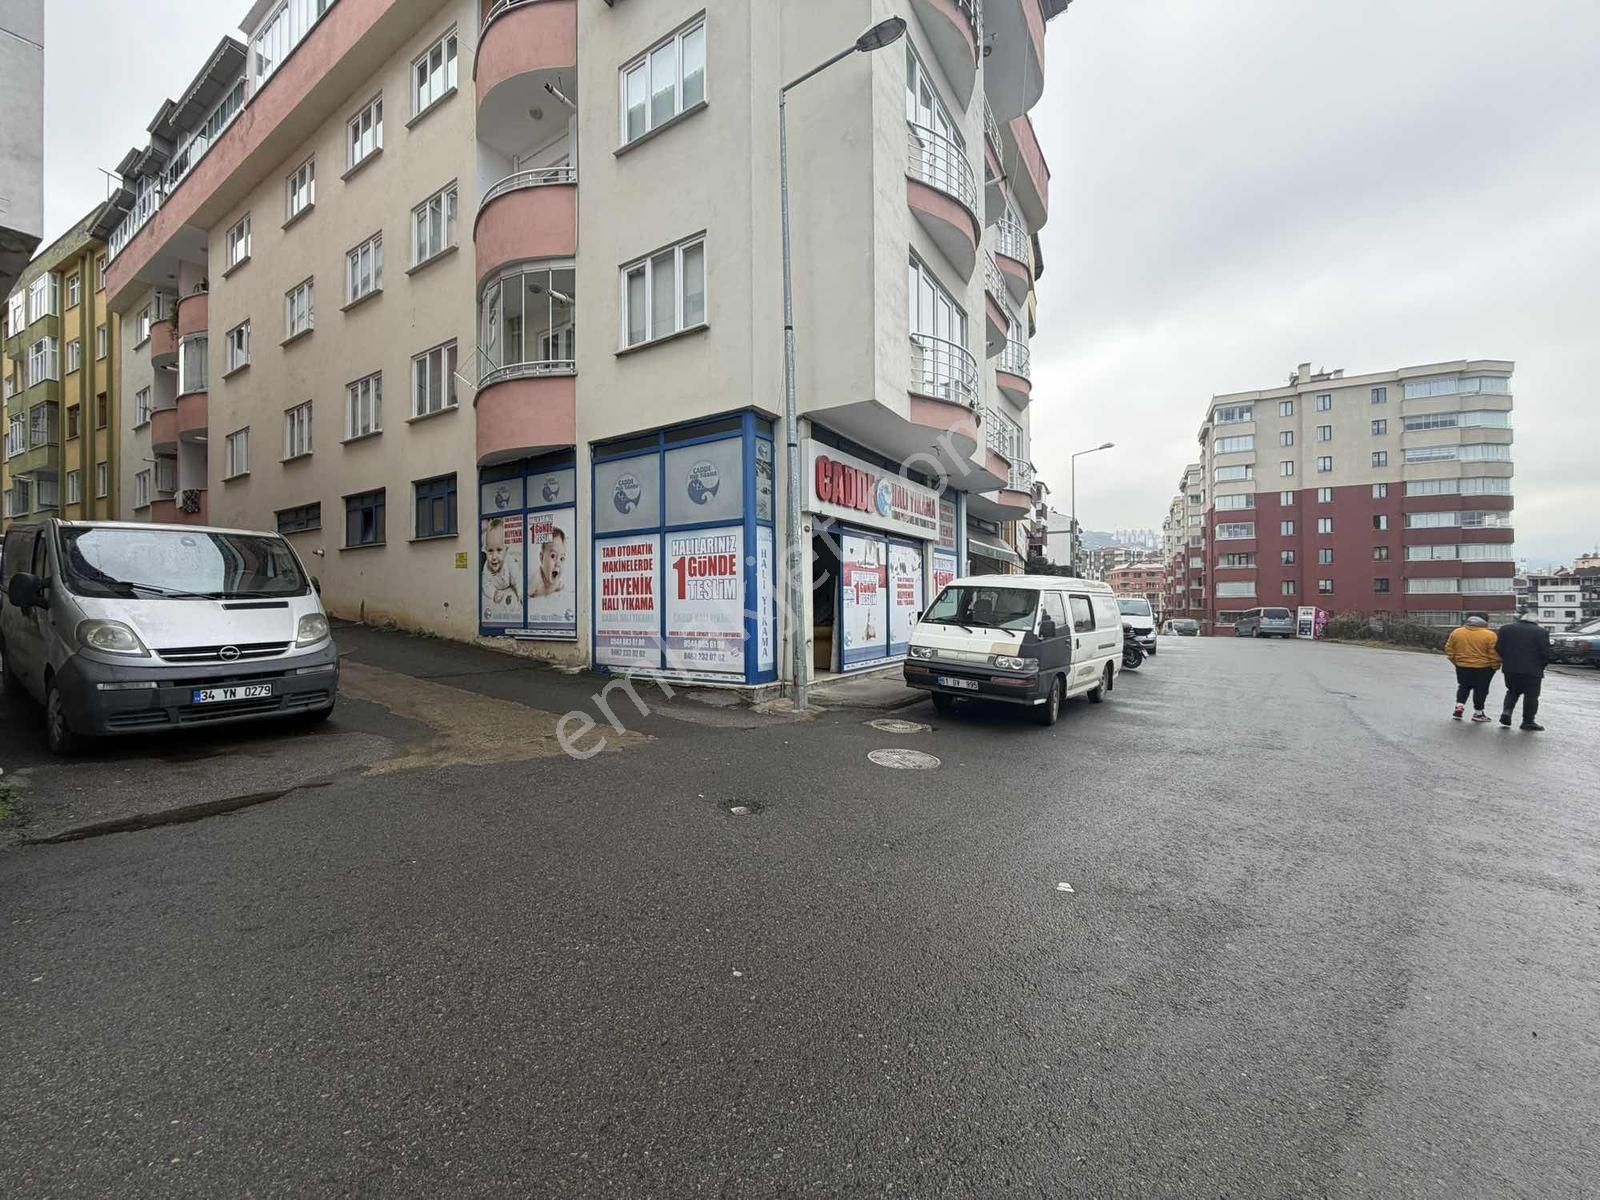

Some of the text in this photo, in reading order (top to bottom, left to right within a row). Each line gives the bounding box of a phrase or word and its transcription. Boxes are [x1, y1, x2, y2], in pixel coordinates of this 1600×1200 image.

[602, 542, 654, 558] TAM OTOMATİK
[672, 534, 737, 556] HALILARINIZ
[602, 558, 653, 573] MAKİNELERDE
[602, 573, 653, 596] HİJYENİK
[672, 554, 737, 600] 1 GÜNDE
[687, 578, 737, 600] TESLİM
[602, 597, 654, 611] HALI YIKAMA
[201, 690, 215, 701] 34
[222, 688, 237, 699] YN
[244, 685, 271, 697] 0279
